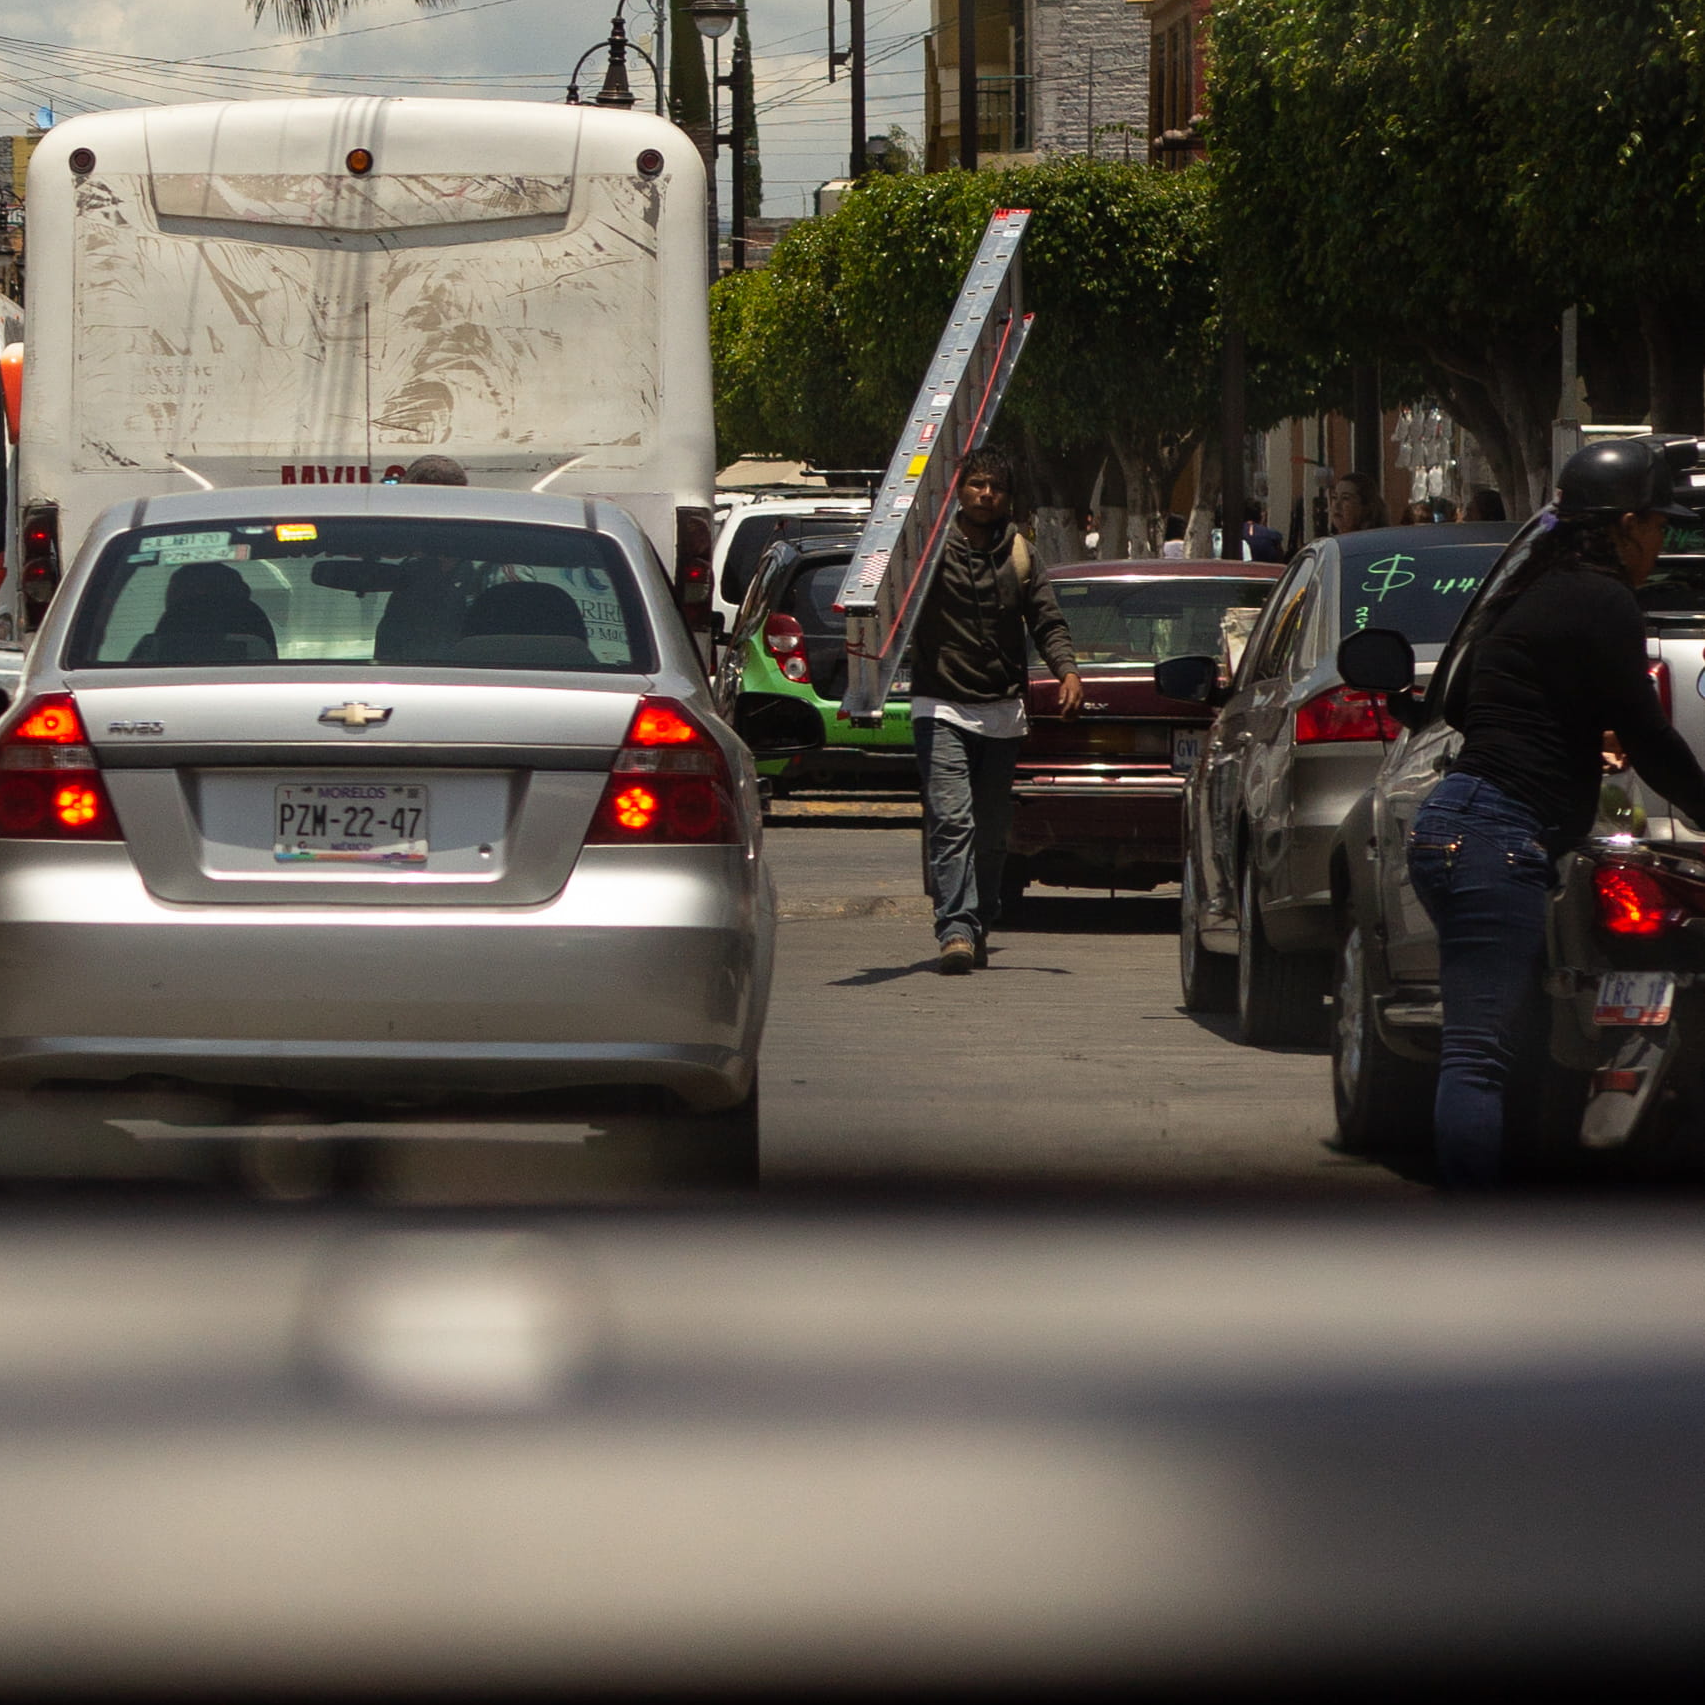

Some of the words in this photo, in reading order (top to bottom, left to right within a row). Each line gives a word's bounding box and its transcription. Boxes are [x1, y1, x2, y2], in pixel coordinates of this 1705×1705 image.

[1361, 553, 1416, 603] $
[1355, 606, 1369, 629] 20
[108, 720, 166, 735] AVEO
[317, 787, 386, 799] MORELOS
[280, 803, 423, 838] PZM-22-47
